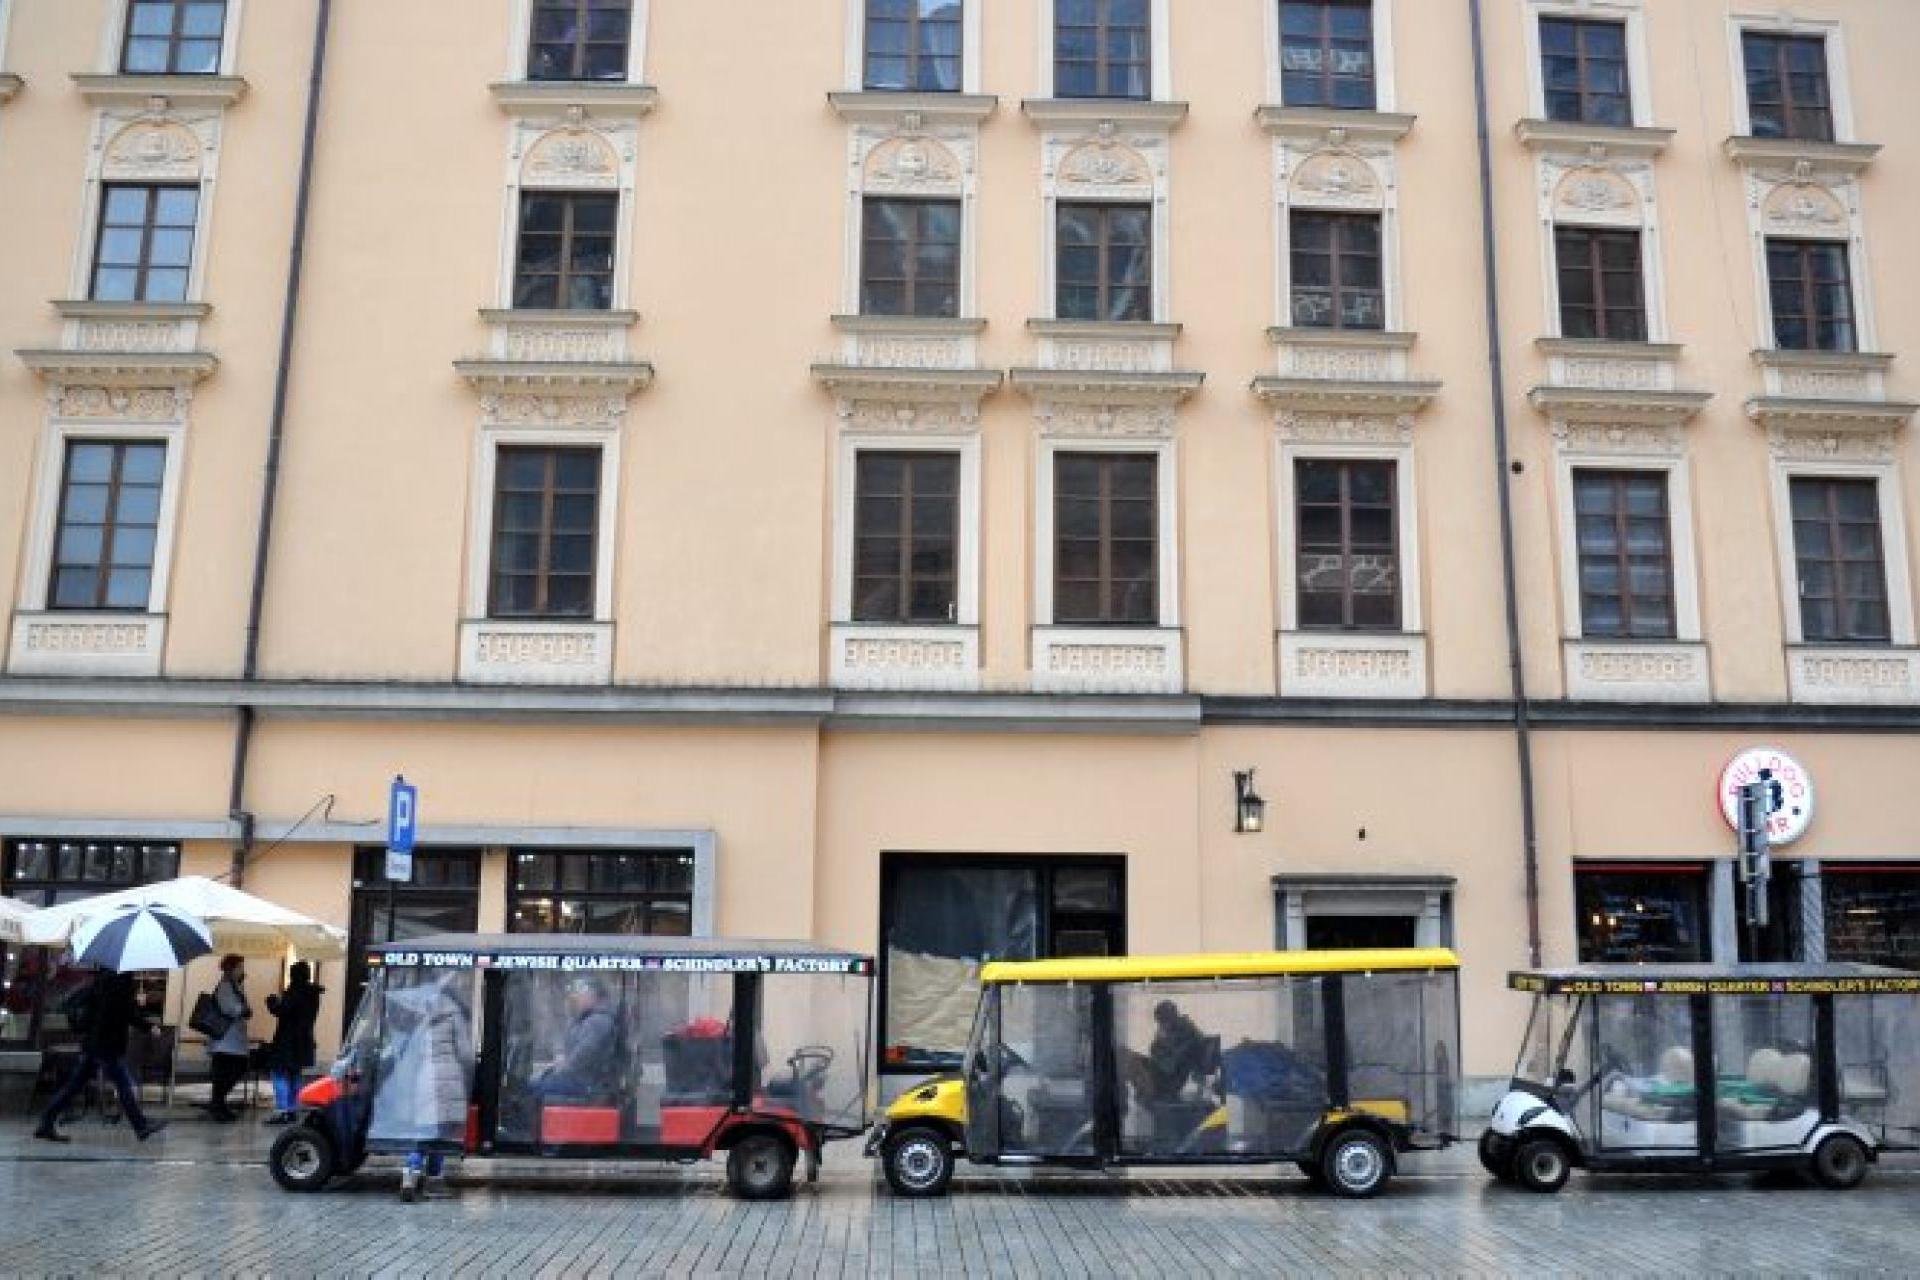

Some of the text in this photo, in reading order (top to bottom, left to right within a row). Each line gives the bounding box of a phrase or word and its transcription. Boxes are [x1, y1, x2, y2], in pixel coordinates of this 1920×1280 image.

[394, 791, 412, 841] P
[385, 953, 850, 971] OLD TOWN JEWISH QUARTER SCHINDLER'S FACTORY
